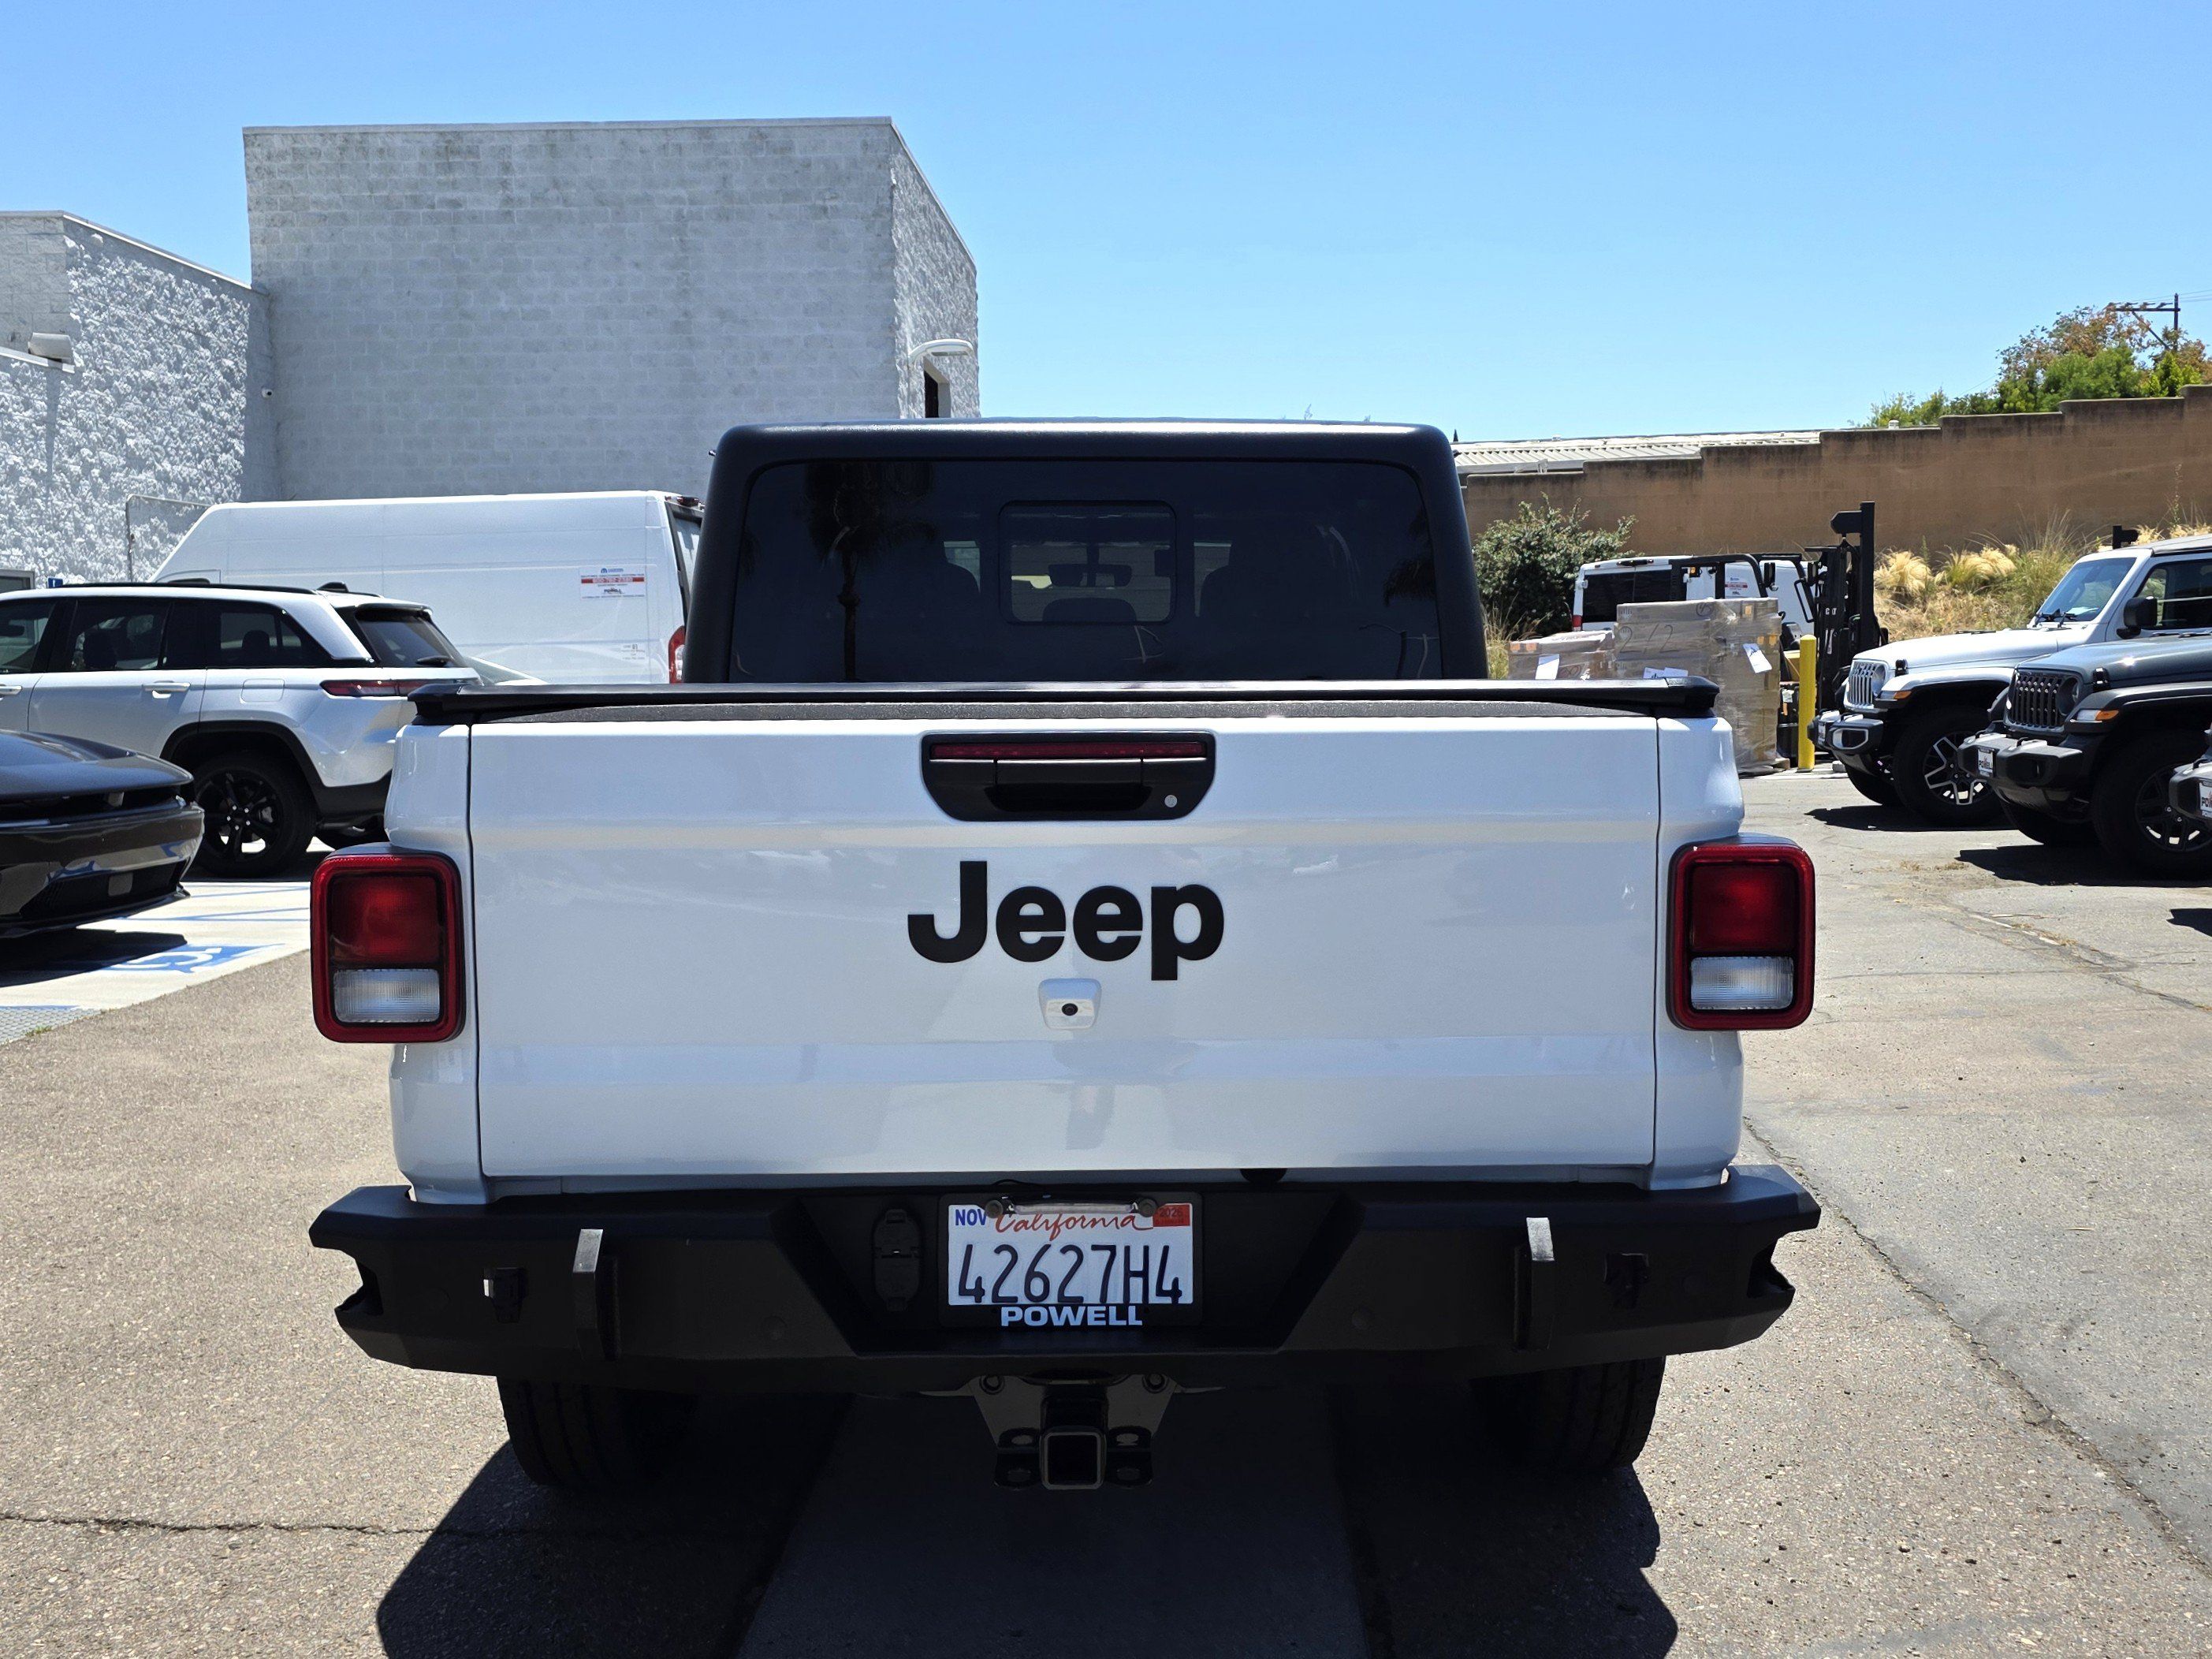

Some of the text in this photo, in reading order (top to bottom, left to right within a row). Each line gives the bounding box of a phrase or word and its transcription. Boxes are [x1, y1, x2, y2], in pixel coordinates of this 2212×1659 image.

[907, 860, 1224, 981] Jeep
[955, 1209, 985, 1226] NOV
[995, 1212, 1153, 1241] California
[958, 1243, 1182, 1303] 42627H4
[1000, 1305, 1143, 1326] POWELL
